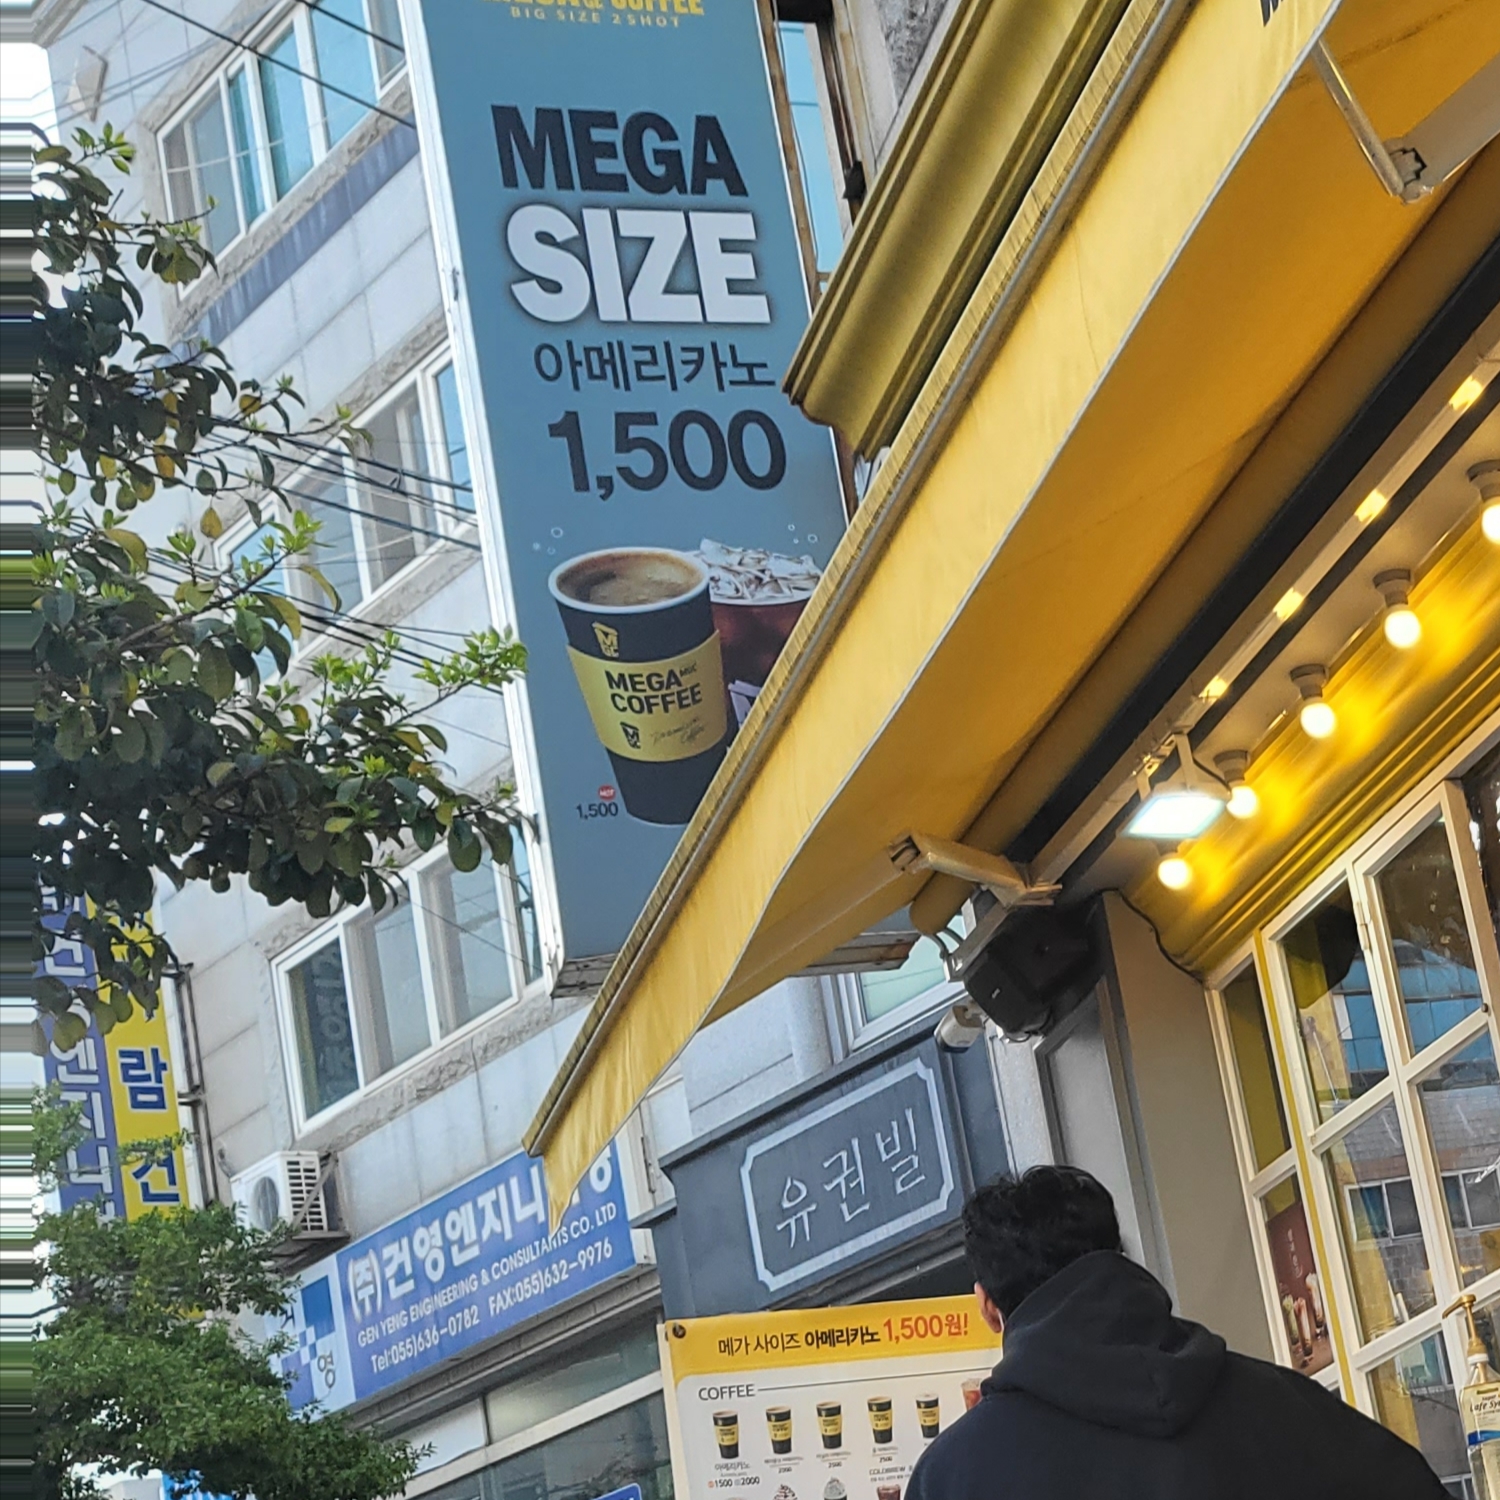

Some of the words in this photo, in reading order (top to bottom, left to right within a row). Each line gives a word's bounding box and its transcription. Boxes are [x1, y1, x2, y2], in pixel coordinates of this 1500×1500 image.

[510, 6, 546, 20] BIG
[557, 11, 601, 24] SIZE
[491, 104, 749, 198] MEGA
[506, 203, 771, 324] SIZE
[534, 340, 776, 392] 아메리카노
[547, 409, 787, 501] 1,500
[605, 668, 682, 692] MEGA
[610, 683, 703, 715] COFFEE
[576, 802, 619, 820] 1,500
[776, 1107, 926, 1249] 유권빌
[357, 1326, 380, 1348] GEN
[380, 1312, 408, 1338] YENG
[409, 1273, 479, 1329] ENGINEERING
[480, 1268, 490, 1287] &
[570, 1217, 596, 1242] CO.
[597, 1202, 618, 1228] LTD
[718, 1336, 750, 1357] 메가
[753, 1332, 801, 1354] 사이즈
[804, 1327, 881, 1349] 아메리카노
[883, 1313, 970, 1344] 1,500원!
[698, 1383, 756, 1402] COFFEE
[714, 1478, 733, 1488] 1500
[741, 1476, 760, 1486] 2000
